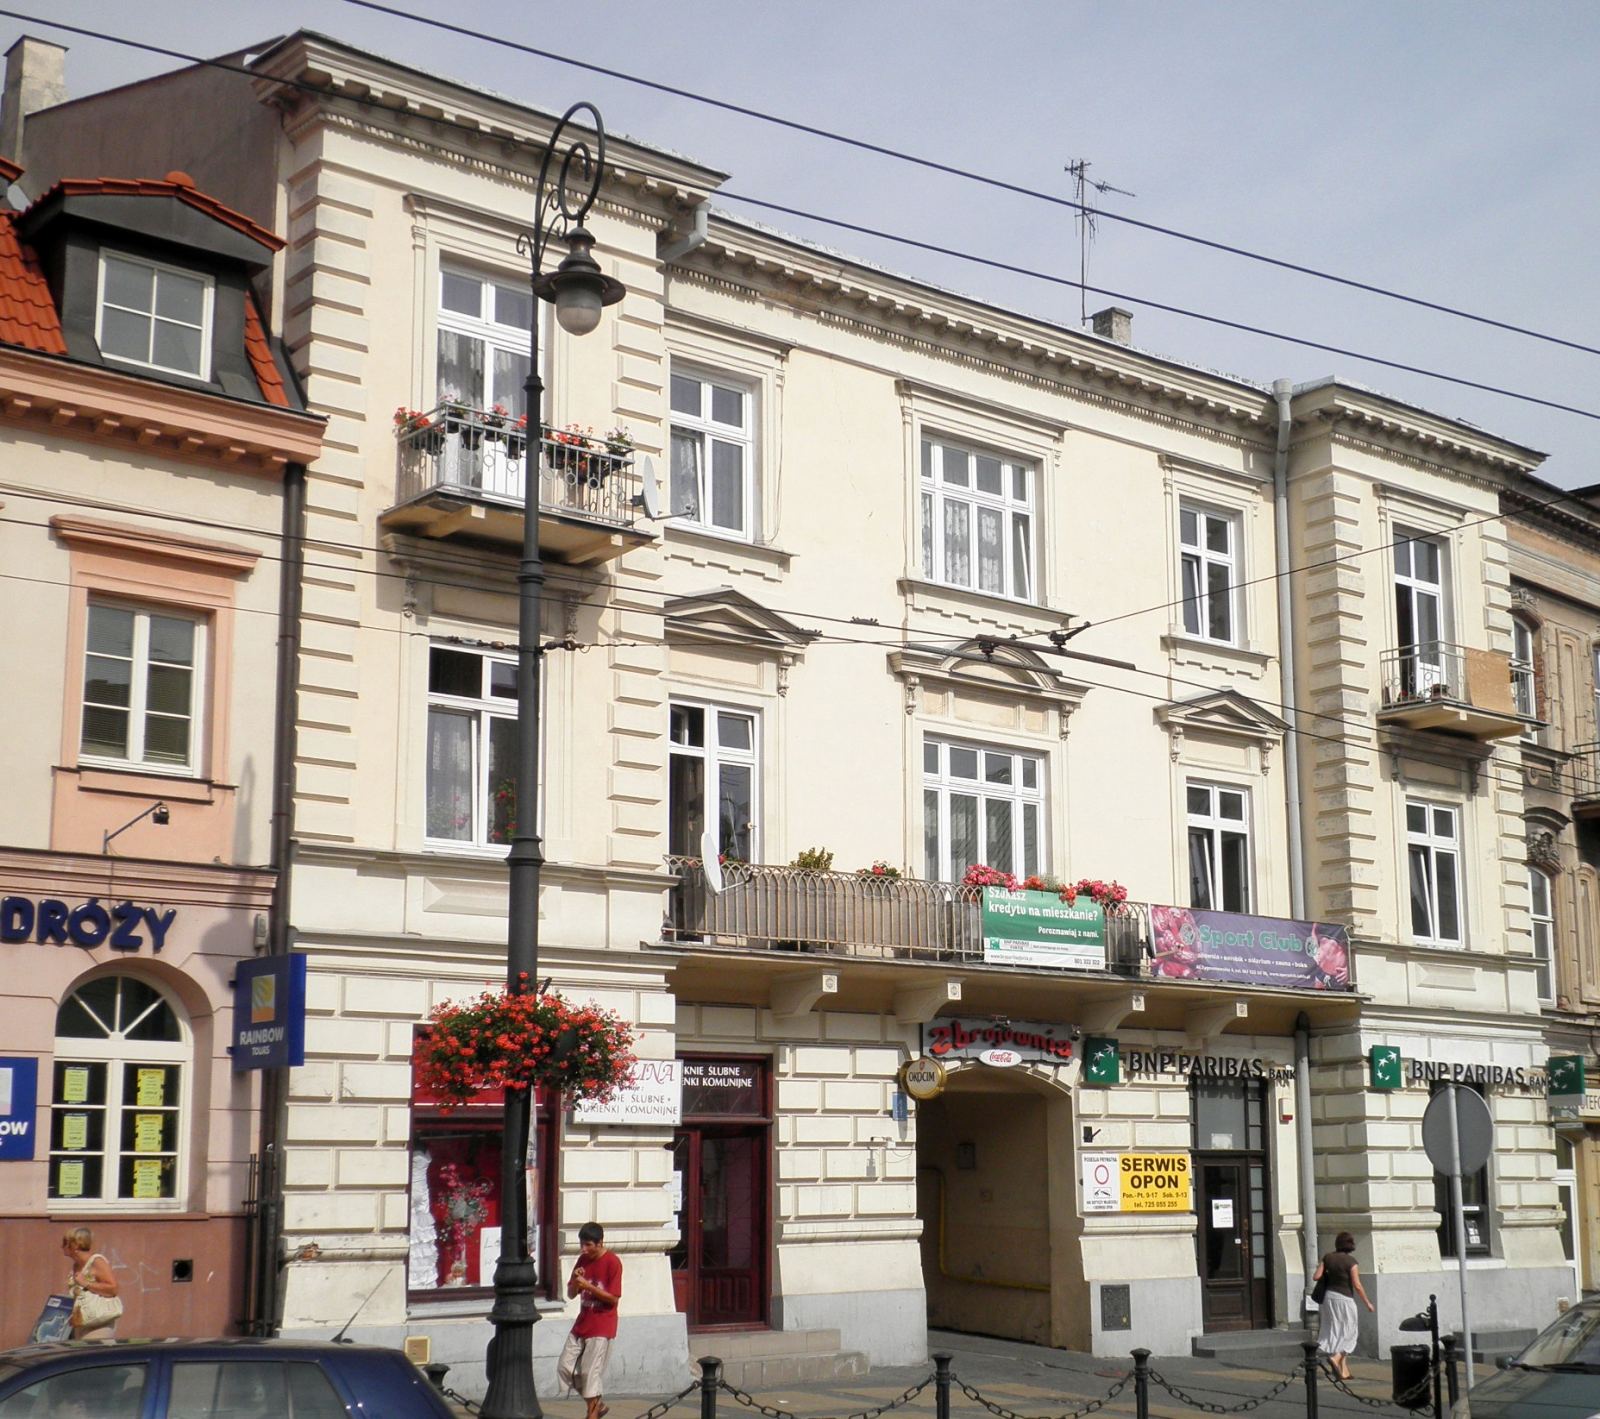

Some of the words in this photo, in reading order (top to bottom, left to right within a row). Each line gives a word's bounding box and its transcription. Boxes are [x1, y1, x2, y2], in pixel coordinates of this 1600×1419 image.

[988, 901, 1027, 917] kredytu
[1028, 907, 1040, 917] na
[1042, 906, 1098, 921] mieszkanie?
[1038, 926, 1077, 938] Porozmawiaj
[1082, 930, 1099, 938] nami.
[1198, 924, 1255, 948] Sport
[1259, 930, 1303, 952] Club
[239, 1026, 284, 1045] RAINBOW
[684, 1066, 704, 1076] KNIE
[1129, 1052, 1173, 1073] BNP
[1178, 1054, 1263, 1078] PARIBAS
[1268, 1068, 1297, 1080] BANK
[1412, 1060, 1449, 1081] BNP
[1453, 1062, 1525, 1085] PARIBAS
[702, 1077, 753, 1089] KOMUNIJNE
[908, 1071, 936, 1083] OKOCIM
[625, 1105, 678, 1115] KOMUNIJNE
[1121, 1158, 1187, 1172] SERWIS
[1130, 1175, 1179, 1189] OPON
